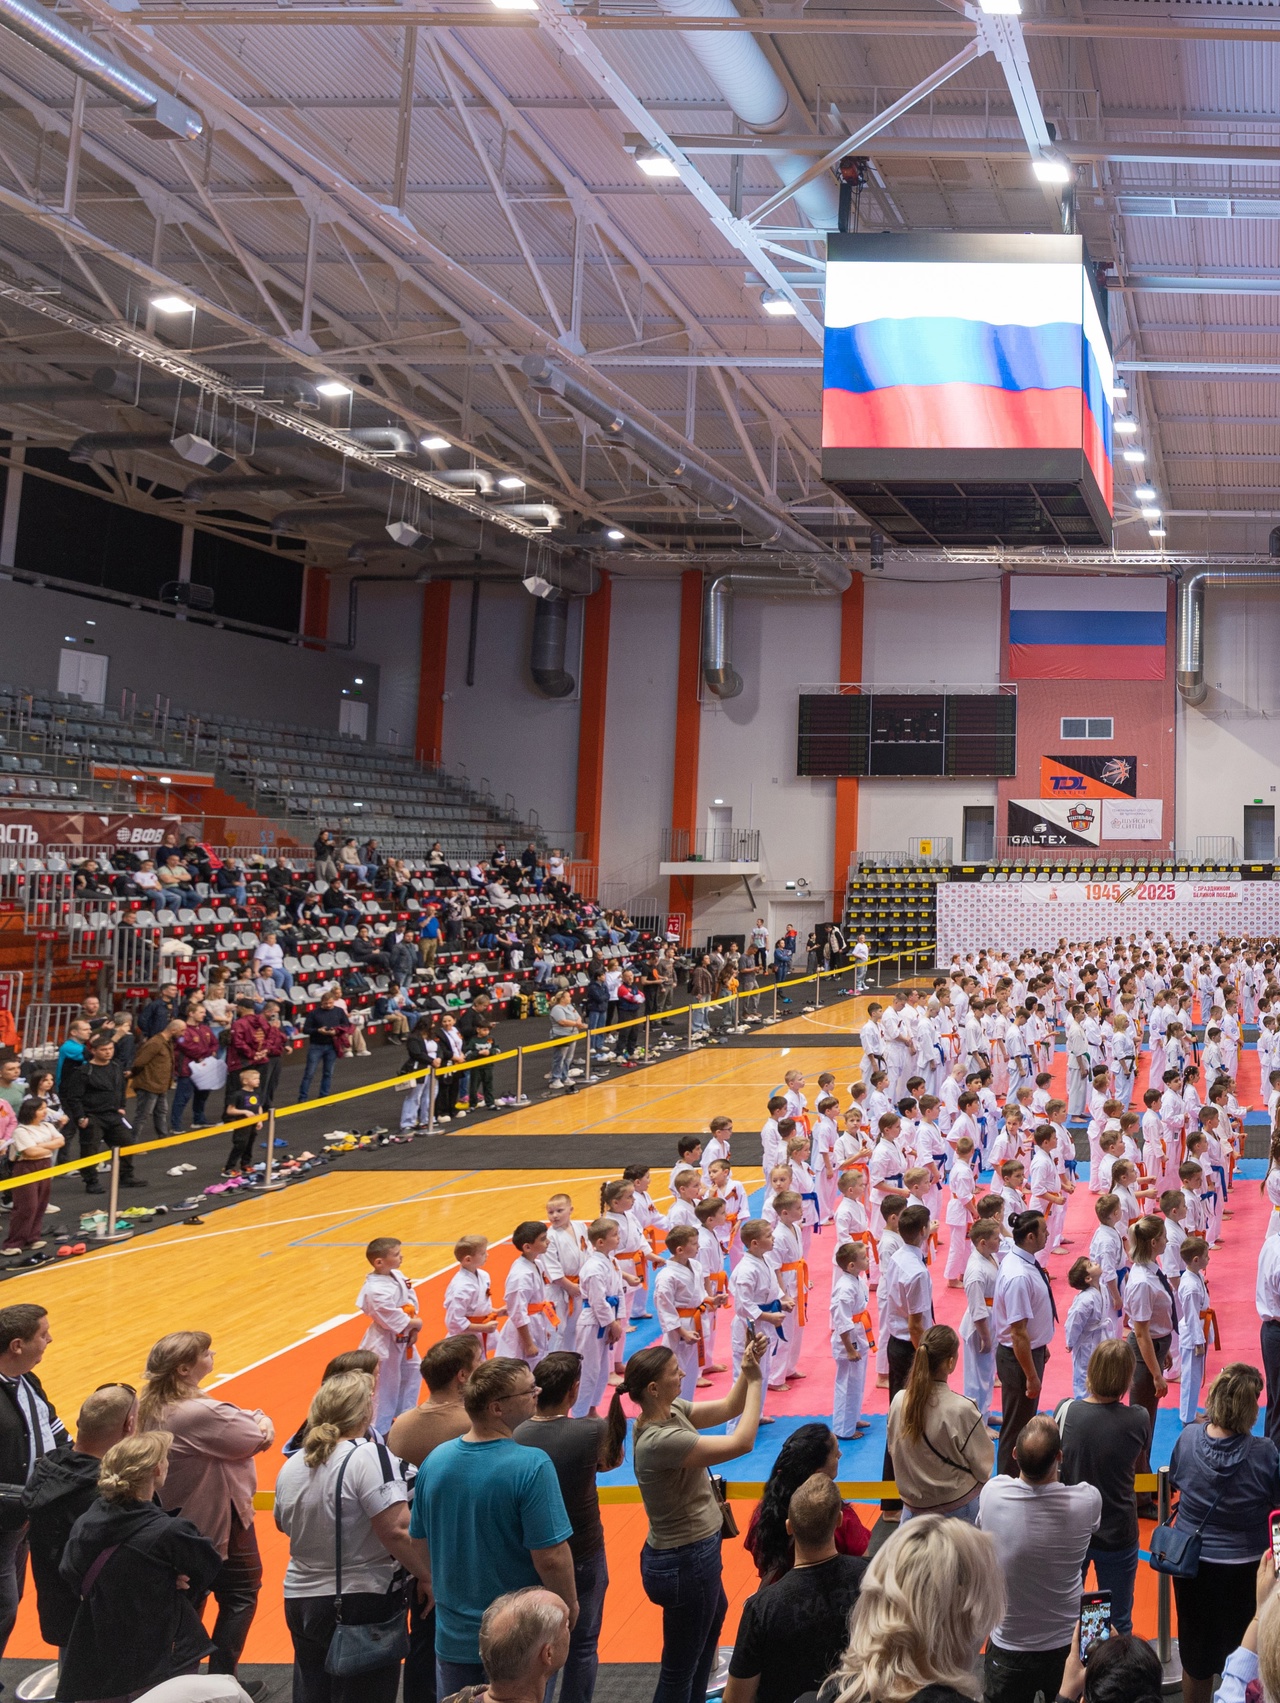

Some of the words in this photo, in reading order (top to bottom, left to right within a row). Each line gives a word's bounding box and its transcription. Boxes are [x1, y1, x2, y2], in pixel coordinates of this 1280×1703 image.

[1049, 776, 1087, 790] TDL
[129, 828, 165, 843] ВФВ
[1011, 835, 1067, 844] GALTEX
[1085, 884, 1121, 901] 1945
[1137, 884, 1176, 901] 2025
